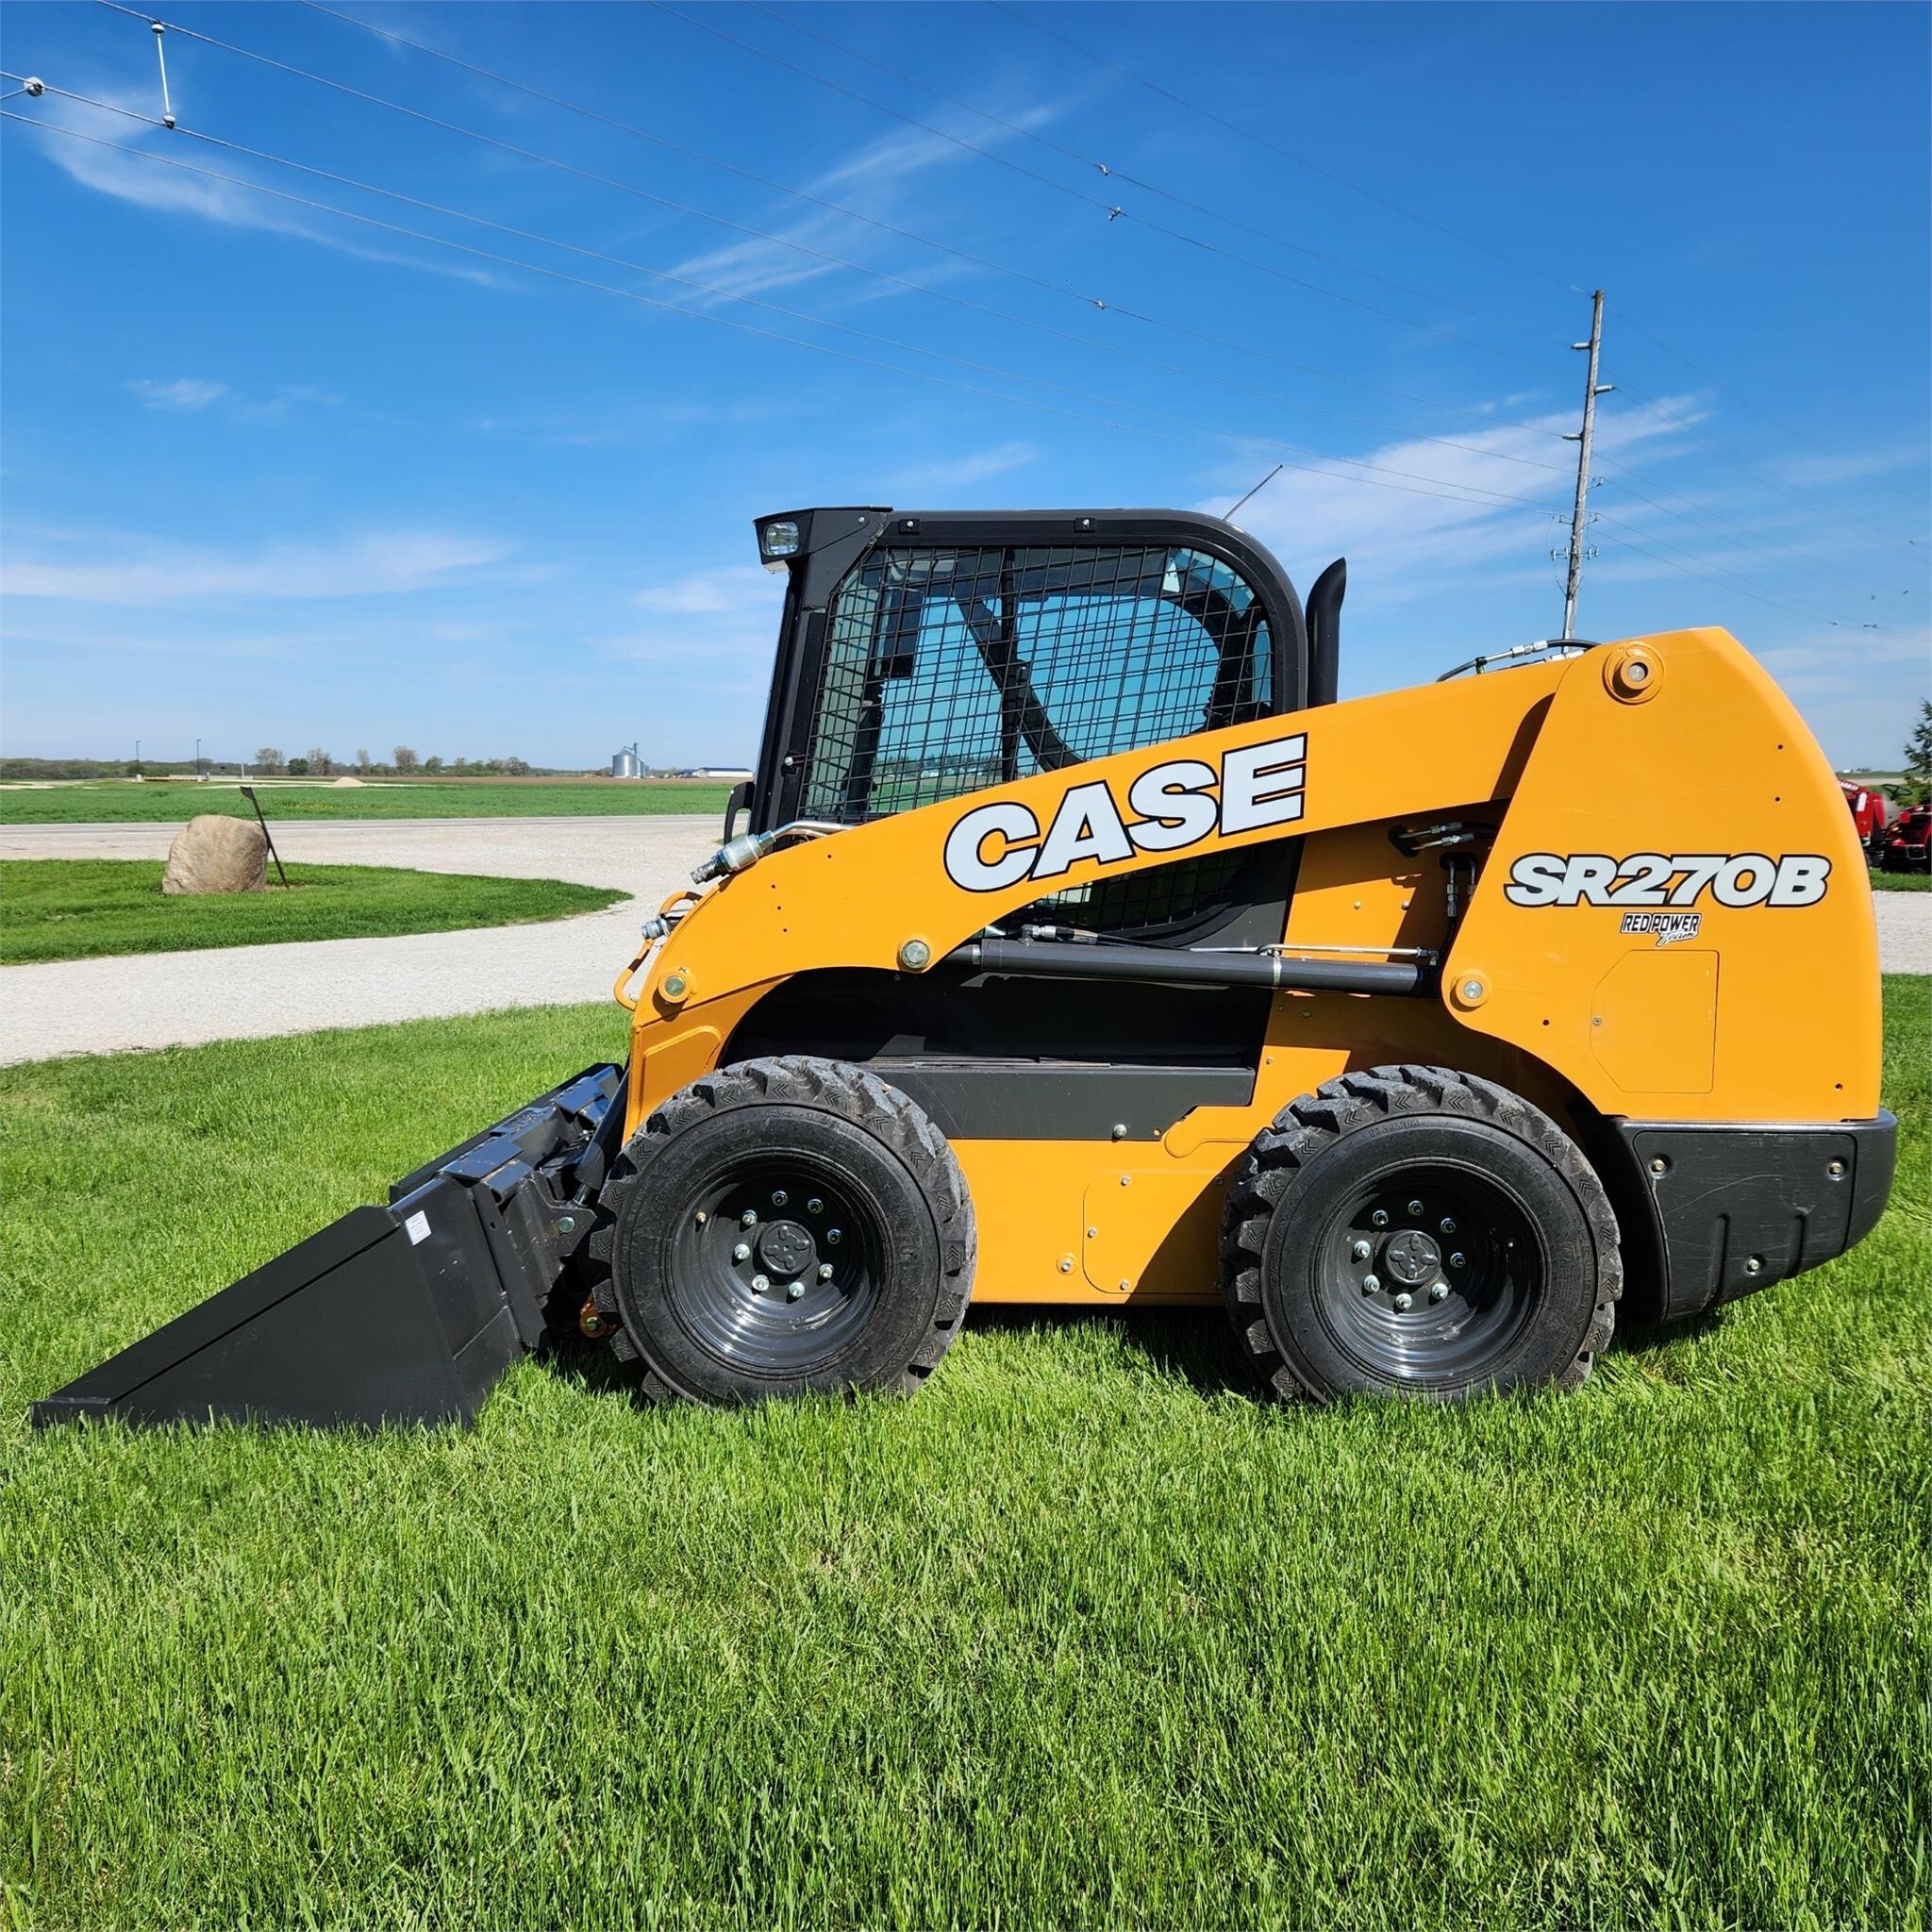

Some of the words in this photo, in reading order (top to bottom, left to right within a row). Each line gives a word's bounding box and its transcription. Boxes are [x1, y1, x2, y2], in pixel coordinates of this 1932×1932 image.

[943, 732, 1308, 893] CASE
[1504, 853, 1832, 908] SR270B
[1622, 914, 1651, 932] RED
[1651, 914, 1700, 933] POWER
[1657, 930, 1695, 946] Team
